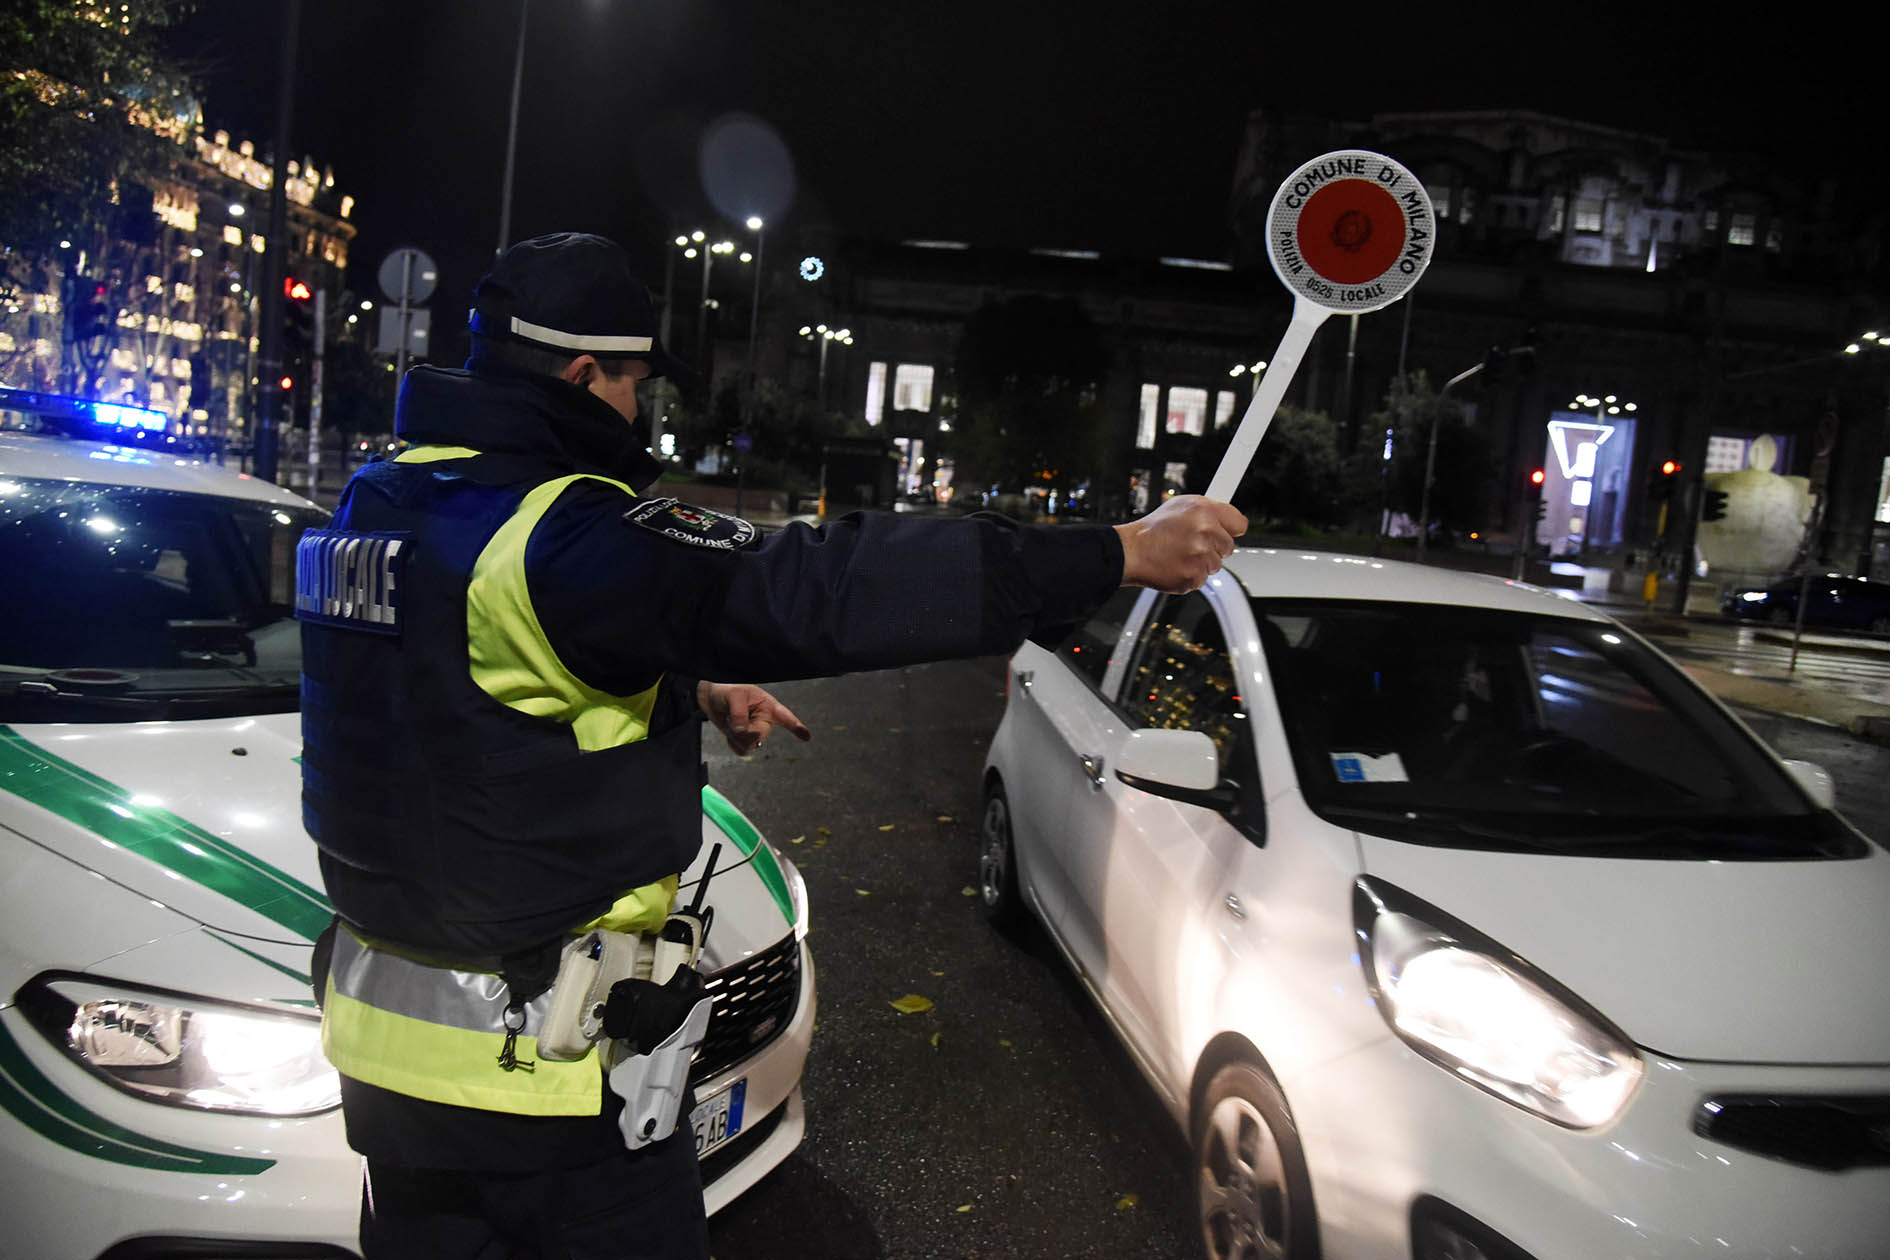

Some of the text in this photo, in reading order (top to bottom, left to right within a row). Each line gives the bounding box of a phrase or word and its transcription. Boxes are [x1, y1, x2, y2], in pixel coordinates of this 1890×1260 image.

[1286, 158, 1427, 274] COMUNE DI MILANO
[1280, 231, 1386, 302] POLIZIA 0525 LOCALE
[665, 528, 734, 549] COMUNE
[323, 537, 402, 625] LOCALE
